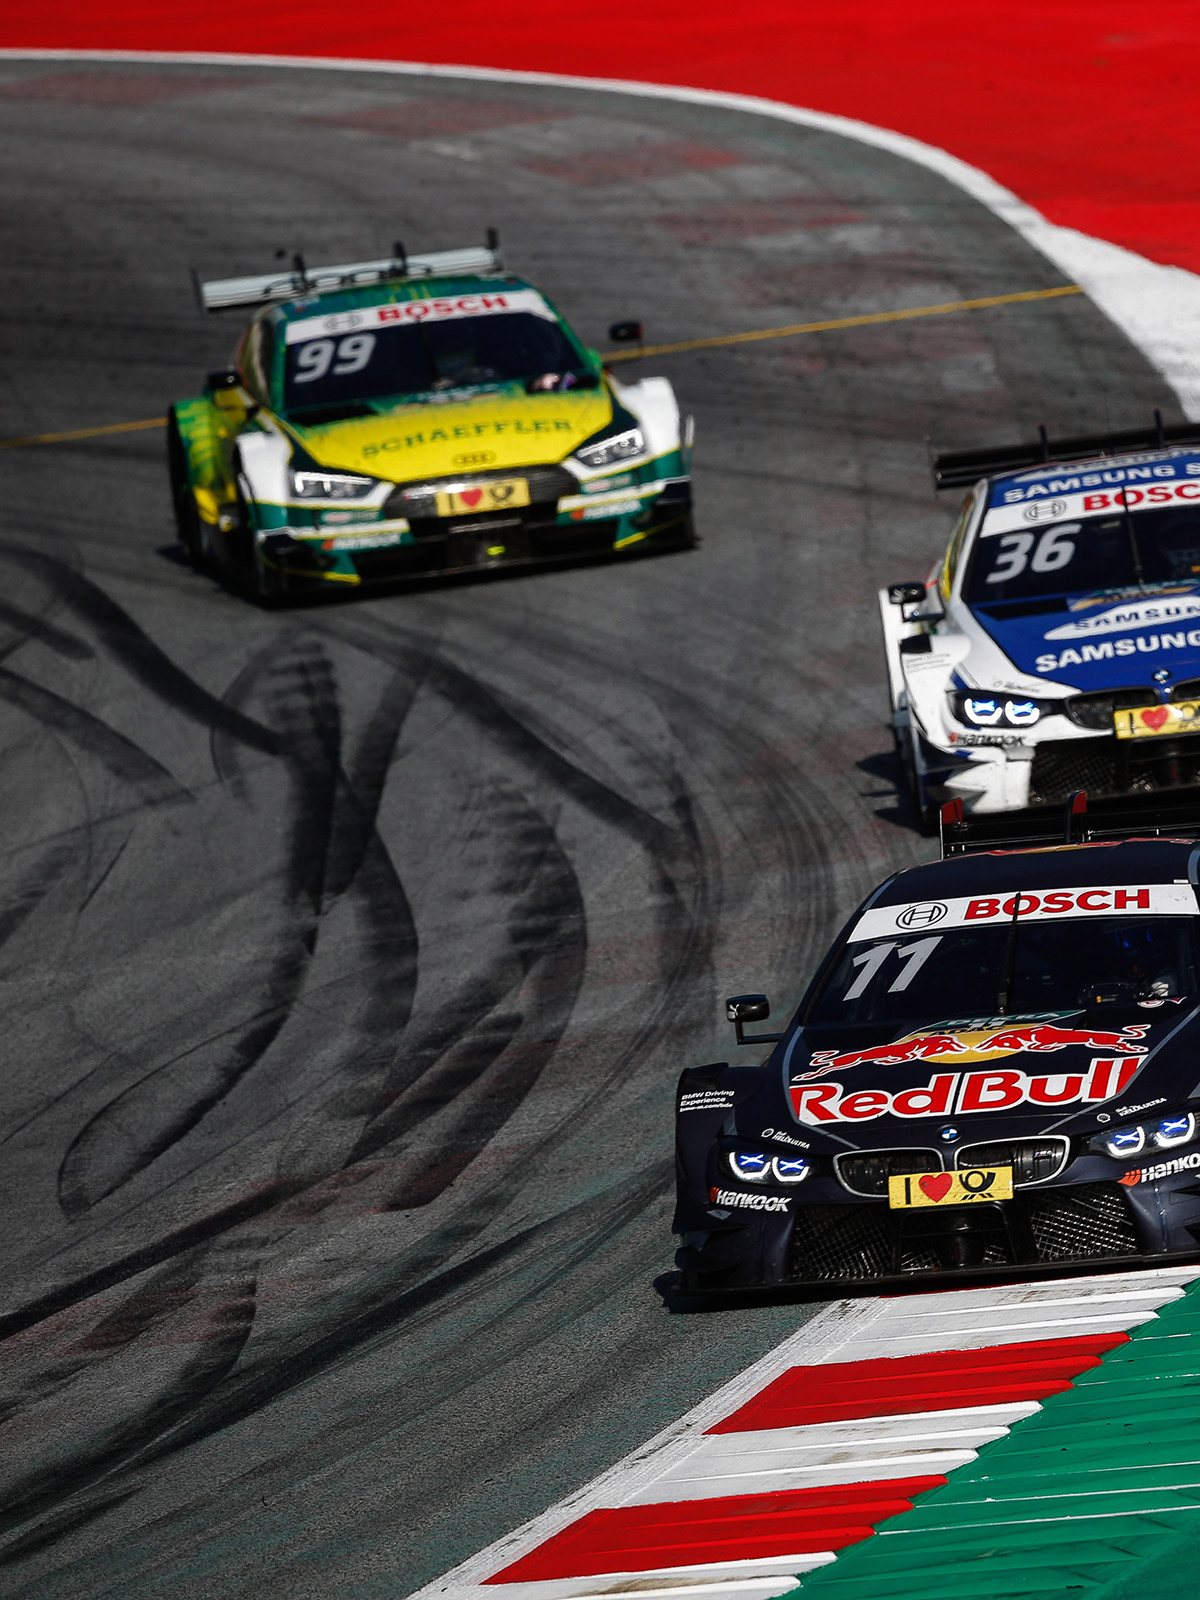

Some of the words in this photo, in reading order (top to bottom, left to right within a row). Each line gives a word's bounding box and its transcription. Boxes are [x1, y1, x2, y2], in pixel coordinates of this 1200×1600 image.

[378, 293, 509, 323] BOSCH
[294, 333, 377, 384] 99
[362, 418, 573, 459] SCHAEFFLER
[1004, 464, 1177, 503] SAMSUNG
[986, 523, 1083, 584] 36
[964, 888, 1150, 920] BOSCH
[843, 936, 943, 1001] 11
[680, 1097, 726, 1107] Experience
[681, 1091, 704, 1100] BMW
